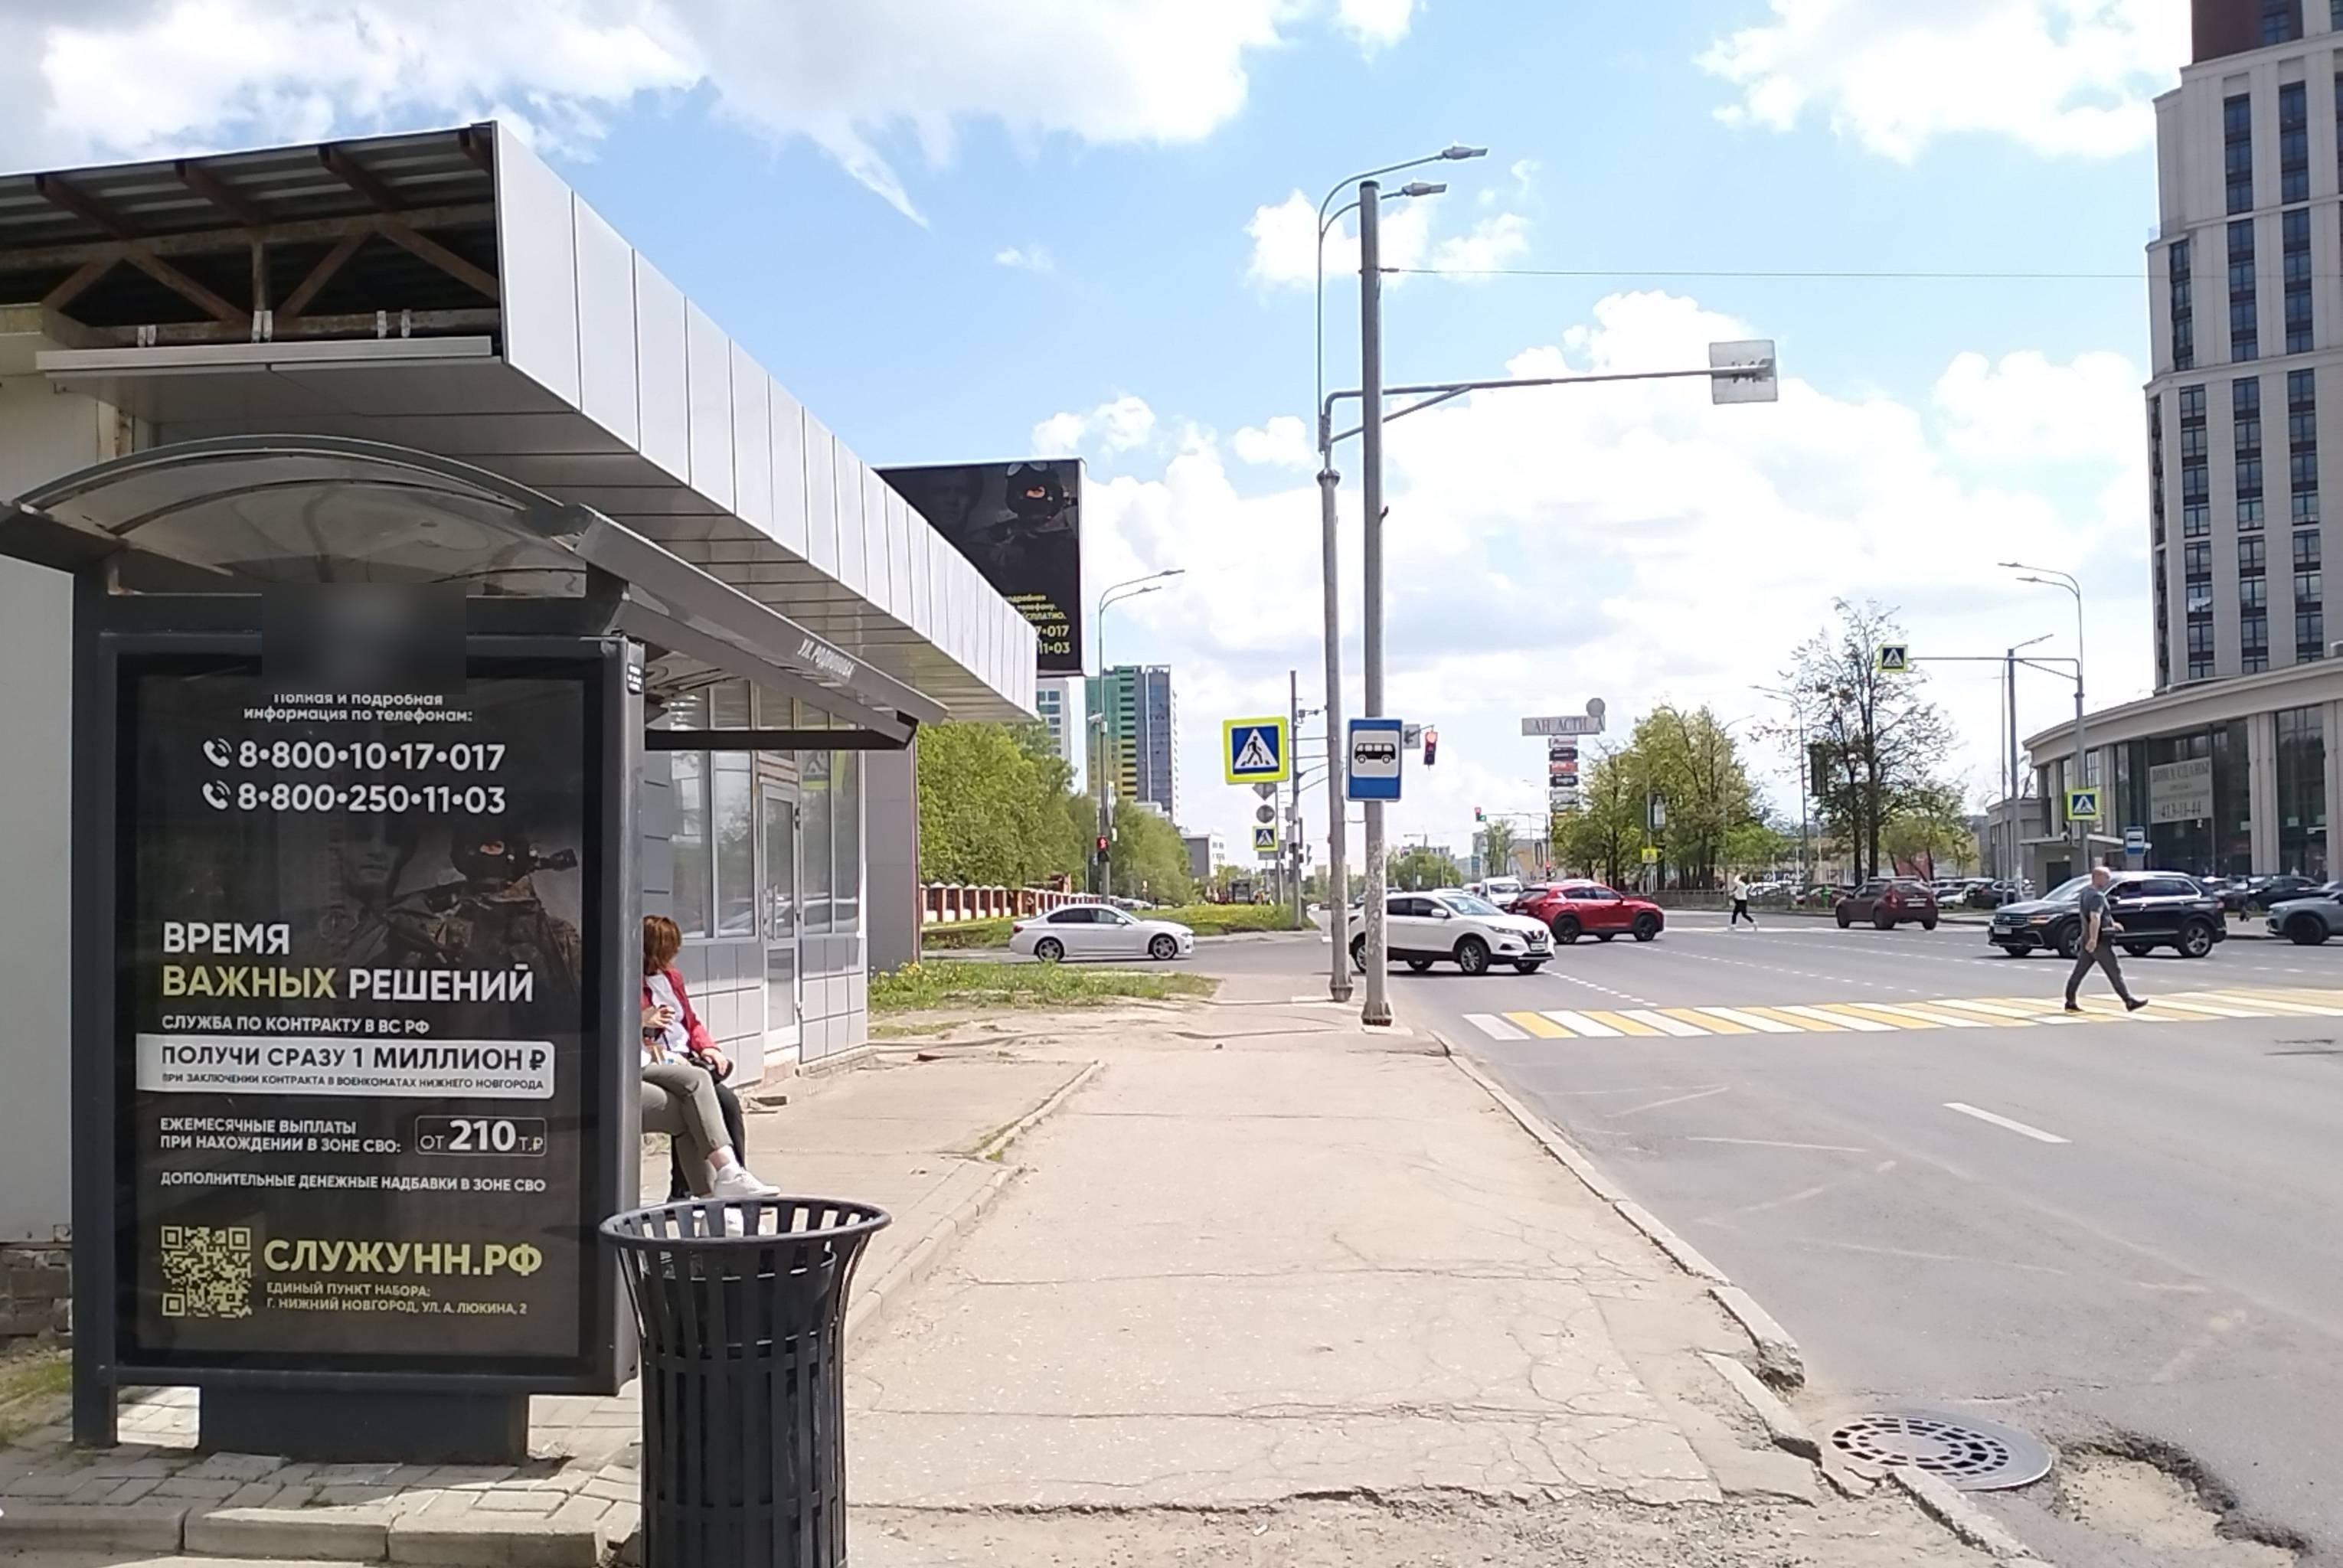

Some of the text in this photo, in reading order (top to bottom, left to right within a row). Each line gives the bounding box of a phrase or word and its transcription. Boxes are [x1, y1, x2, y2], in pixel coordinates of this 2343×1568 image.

[273, 694, 443, 707] Полная и подробная
[243, 706, 472, 724] информация по телефонам:
[162, 922, 290, 955] ВРЕМЯ
[162, 963, 534, 1001] ВАЖНЫХ РЕШЕНИЙ
[162, 1015, 430, 1034] СЛУЖБА ПО КОНТРАКТУ В ВС РФ
[162, 1046, 260, 1065] ПОЛУЧИ
[267, 1047, 346, 1067] СРАЗУ
[352, 1047, 362, 1068] 1
[374, 1047, 522, 1070] МИЛЛИОН
[162, 1073, 544, 1089] ПРИ ЗАКЛЮЧЕНИИ КОНТРАКТА В ВОЕНКОМАТАХ НИЖНЕГО НОВГОРОДА
[160, 1117, 357, 1135] ЕЖЕМЕСЯЧНЫЕ ВЫПЛАТЫ
[160, 1135, 401, 1153] ПРИ НАХОЖДЕНИИ В ЗОНЕ СВО:
[420, 1135, 445, 1149] ОТ
[448, 1119, 516, 1152] 210
[160, 1172, 546, 1191] ДОПОЛНИТЕЛЬНЫЕ ДЕНЕЖНЫЕ НАДБАВКИ В ЗОНЕ СВО
[264, 1239, 542, 1276] СЛУЖУНН.РФ
[267, 1281, 430, 1297] ЕДИНЫЙ ПУНКТ НАБОРА:
[267, 1298, 275, 1308] Г.
[279, 1297, 338, 1310] НИЖНИЙ
[422, 1302, 441, 1313] УЛ.
[443, 1302, 455, 1313] А.
[457, 1302, 518, 1315] ЛЮКИНА,
[519, 1303, 528, 1315] 2
